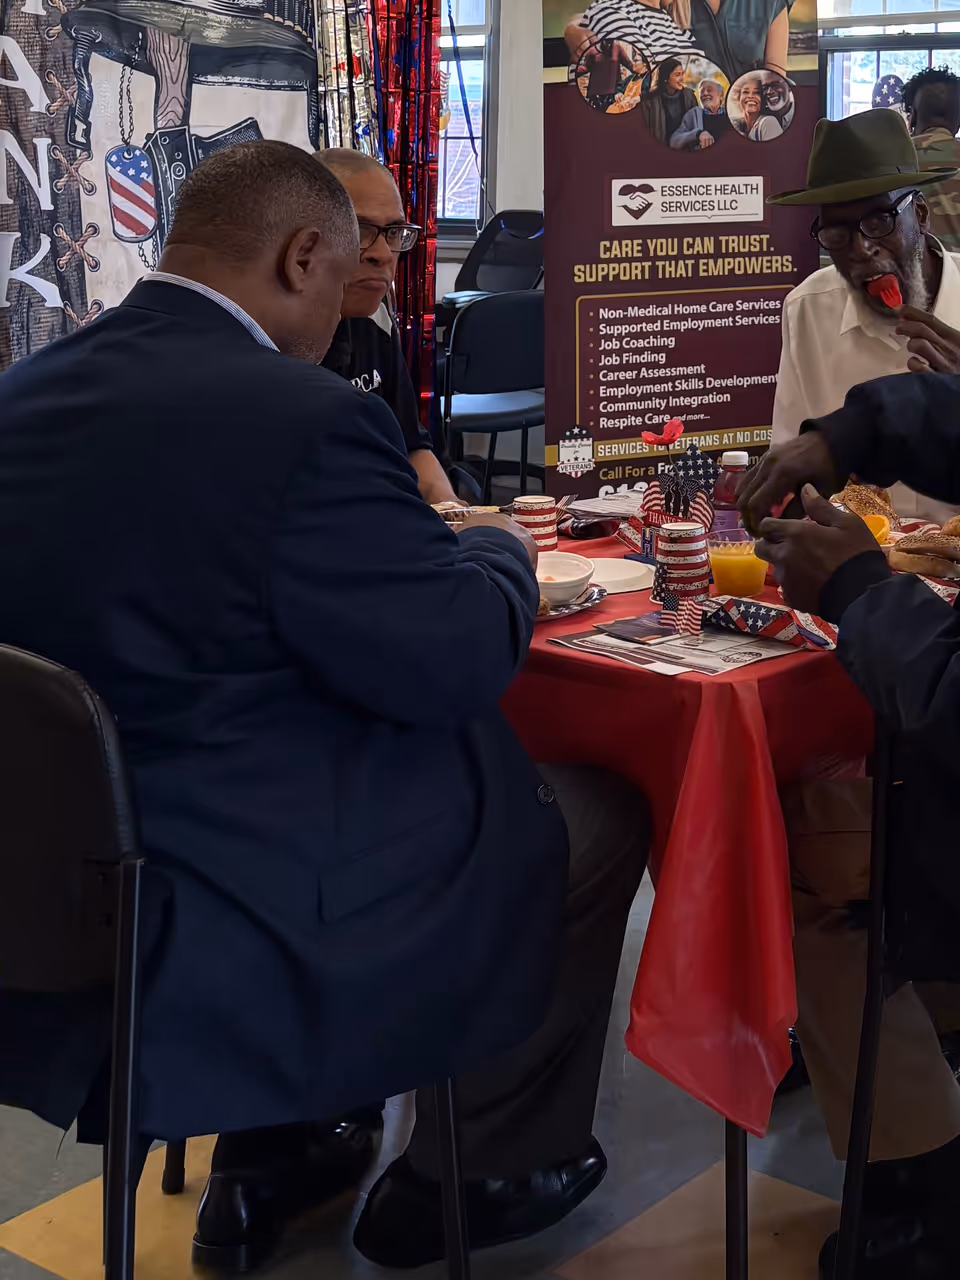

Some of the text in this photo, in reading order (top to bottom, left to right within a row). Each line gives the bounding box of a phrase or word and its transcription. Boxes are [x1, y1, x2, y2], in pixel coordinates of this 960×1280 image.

[660, 183, 759, 197] ESSENCE HEALTH
[660, 199, 738, 213] SERVICES LLC
[600, 234, 774, 258] CARE YOU CAN TRUST.
[574, 255, 798, 283] SUPPORT THAT EMPOWERS.
[599, 299, 781, 319] Non-Medical Home Care Services
[599, 313, 780, 336] Supported Employment Services
[599, 334, 675, 351] Job Coaching
[599, 351, 666, 366] Job Finding
[599, 363, 705, 382] Career Assessment
[599, 373, 778, 399] Employment Skills Development
[599, 391, 731, 415] Community Integration
[600, 415, 642, 430] Respite
[644, 412, 671, 424] Care
[598, 441, 649, 456] SERVICES
[671, 432, 720, 449] VETERANS
[723, 430, 734, 446] AT
[737, 429, 751, 443] NO
[753, 428, 772, 441] COS
[561, 463, 592, 472] VETERANS
[600, 462, 673, 480] Call For a Fr
